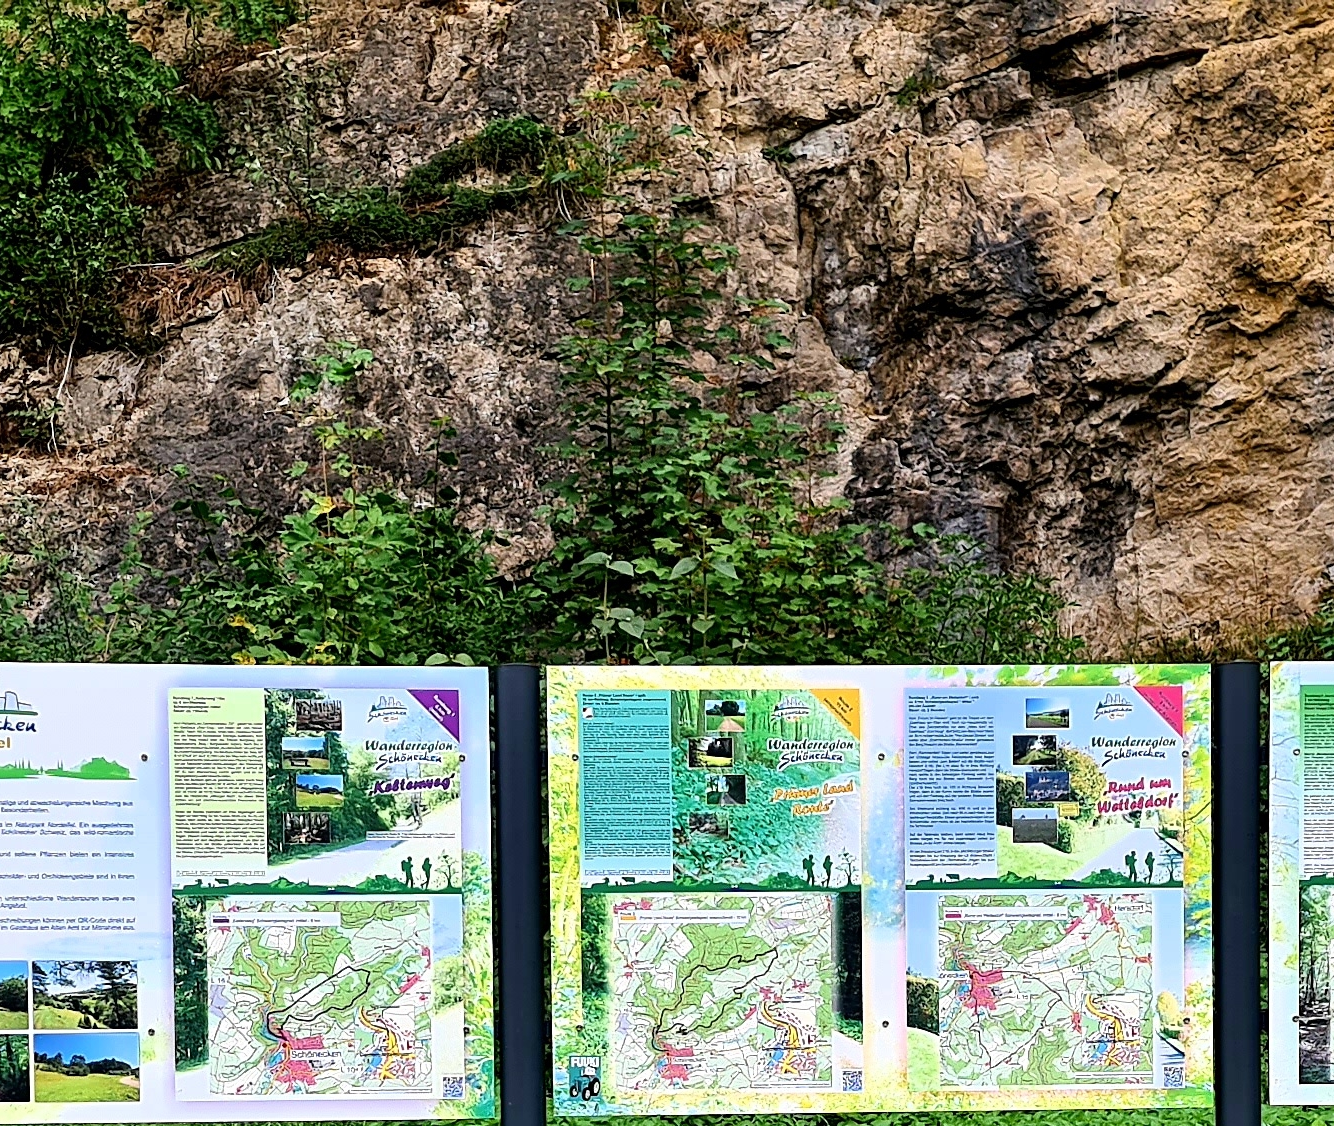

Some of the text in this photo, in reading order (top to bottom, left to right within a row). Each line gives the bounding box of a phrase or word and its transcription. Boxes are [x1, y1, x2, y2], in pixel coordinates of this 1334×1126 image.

[365, 740, 452, 753] Wanderregion
[768, 739, 854, 751] Wanderregion
[1091, 736, 1177, 748] Wanderregion
